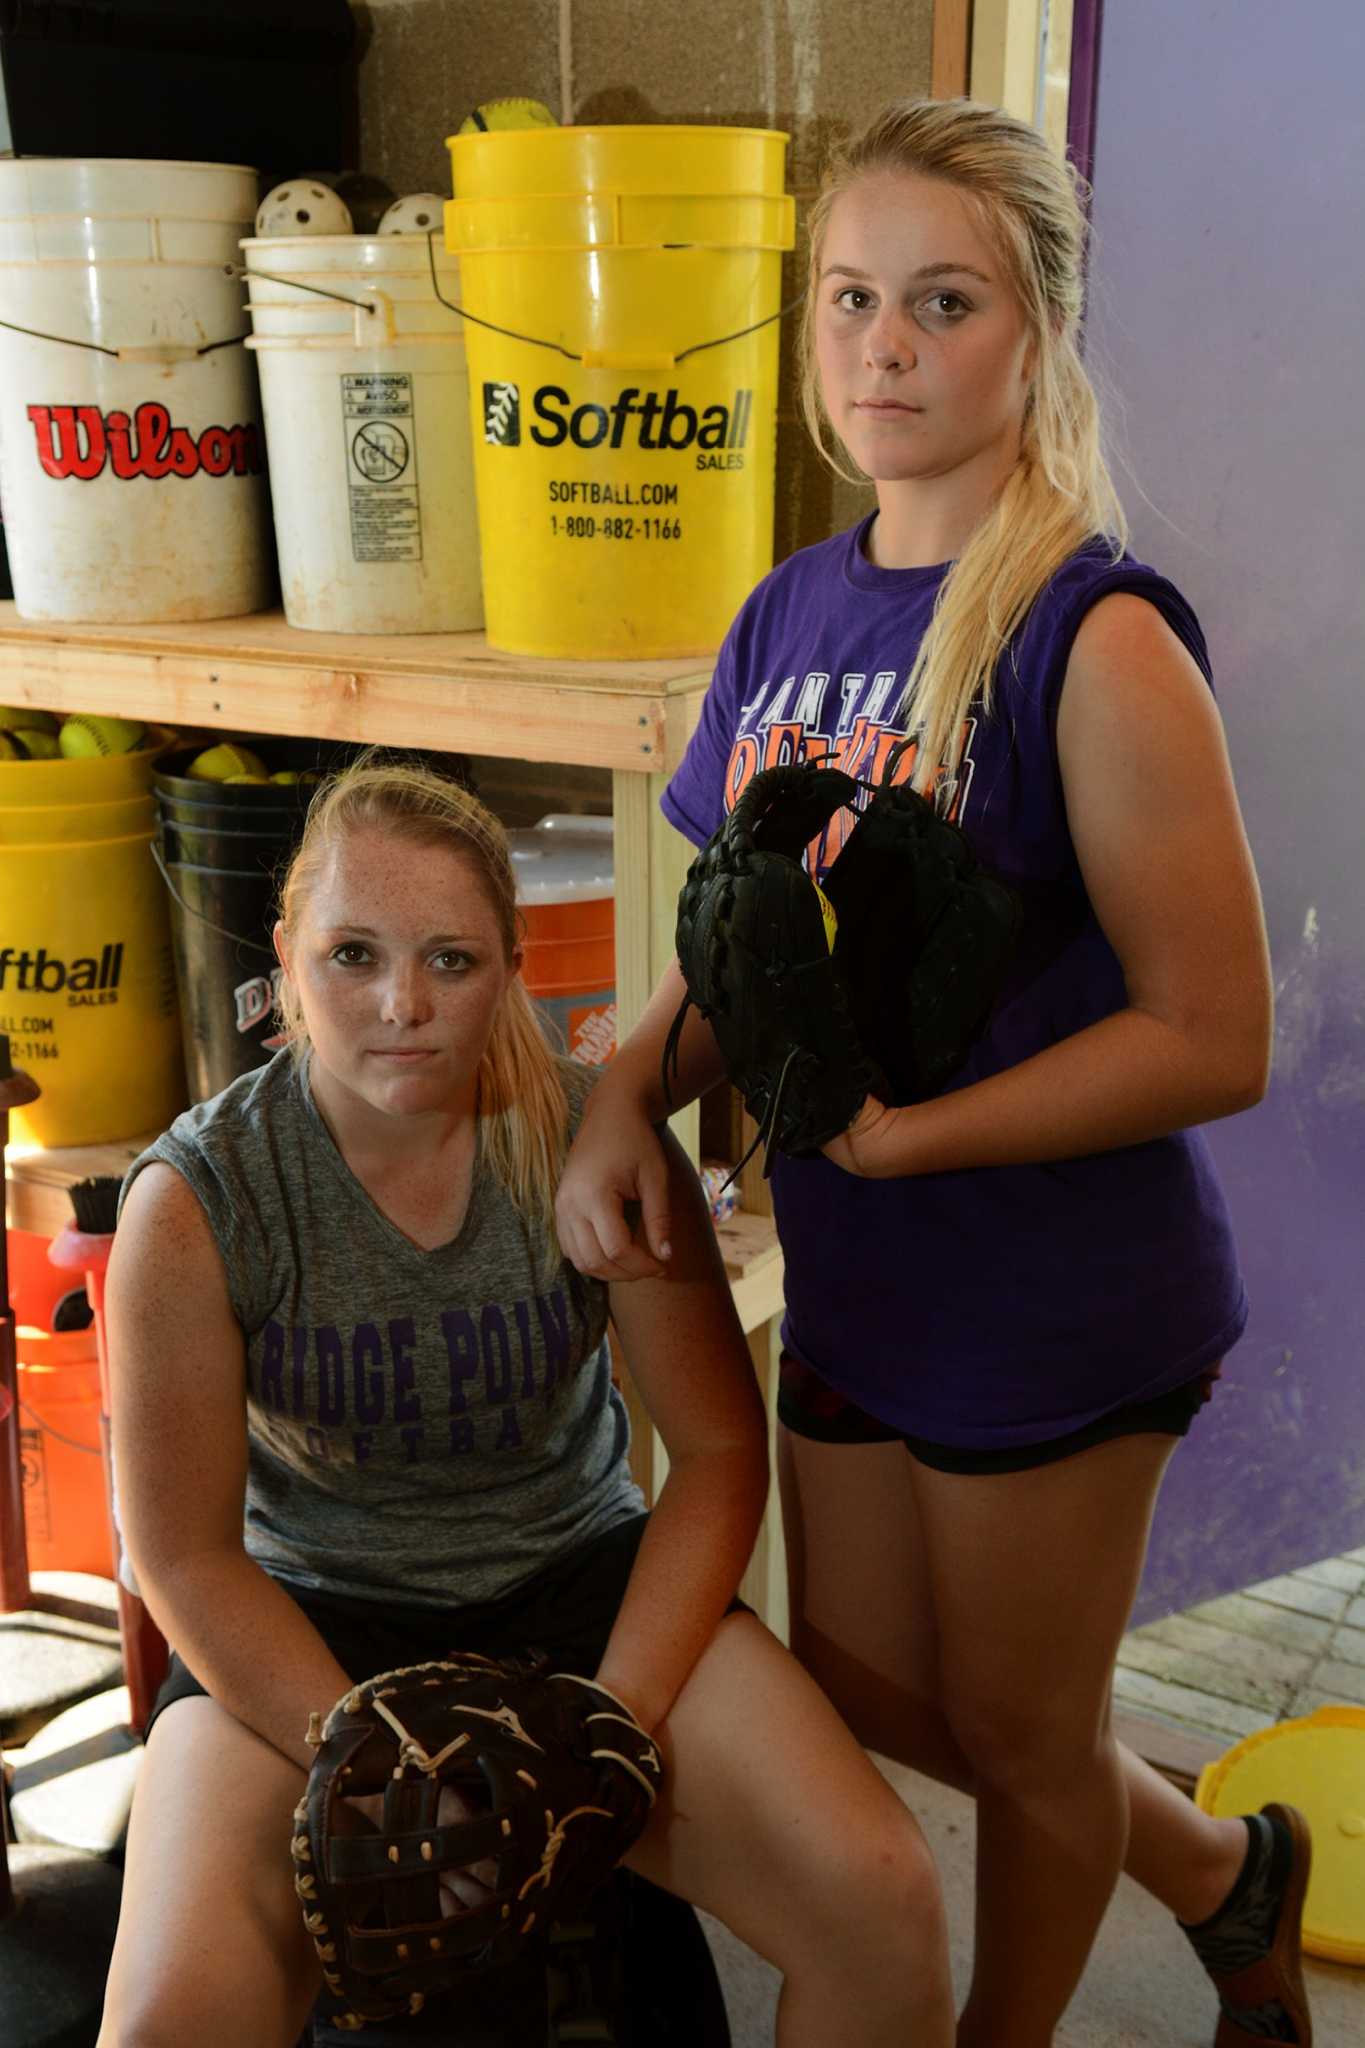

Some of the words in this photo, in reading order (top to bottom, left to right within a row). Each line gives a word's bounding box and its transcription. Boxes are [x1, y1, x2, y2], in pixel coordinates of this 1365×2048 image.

[529, 385, 753, 450] Softball
[26, 401, 260, 480] Wilson
[696, 454, 744, 471] SALES
[549, 481, 678, 505] SOFTBALL.COM
[550, 516, 681, 539] 1-800-882-1166
[67, 990, 119, 1008] SALES
[260, 1316, 421, 1426] RIDGE
